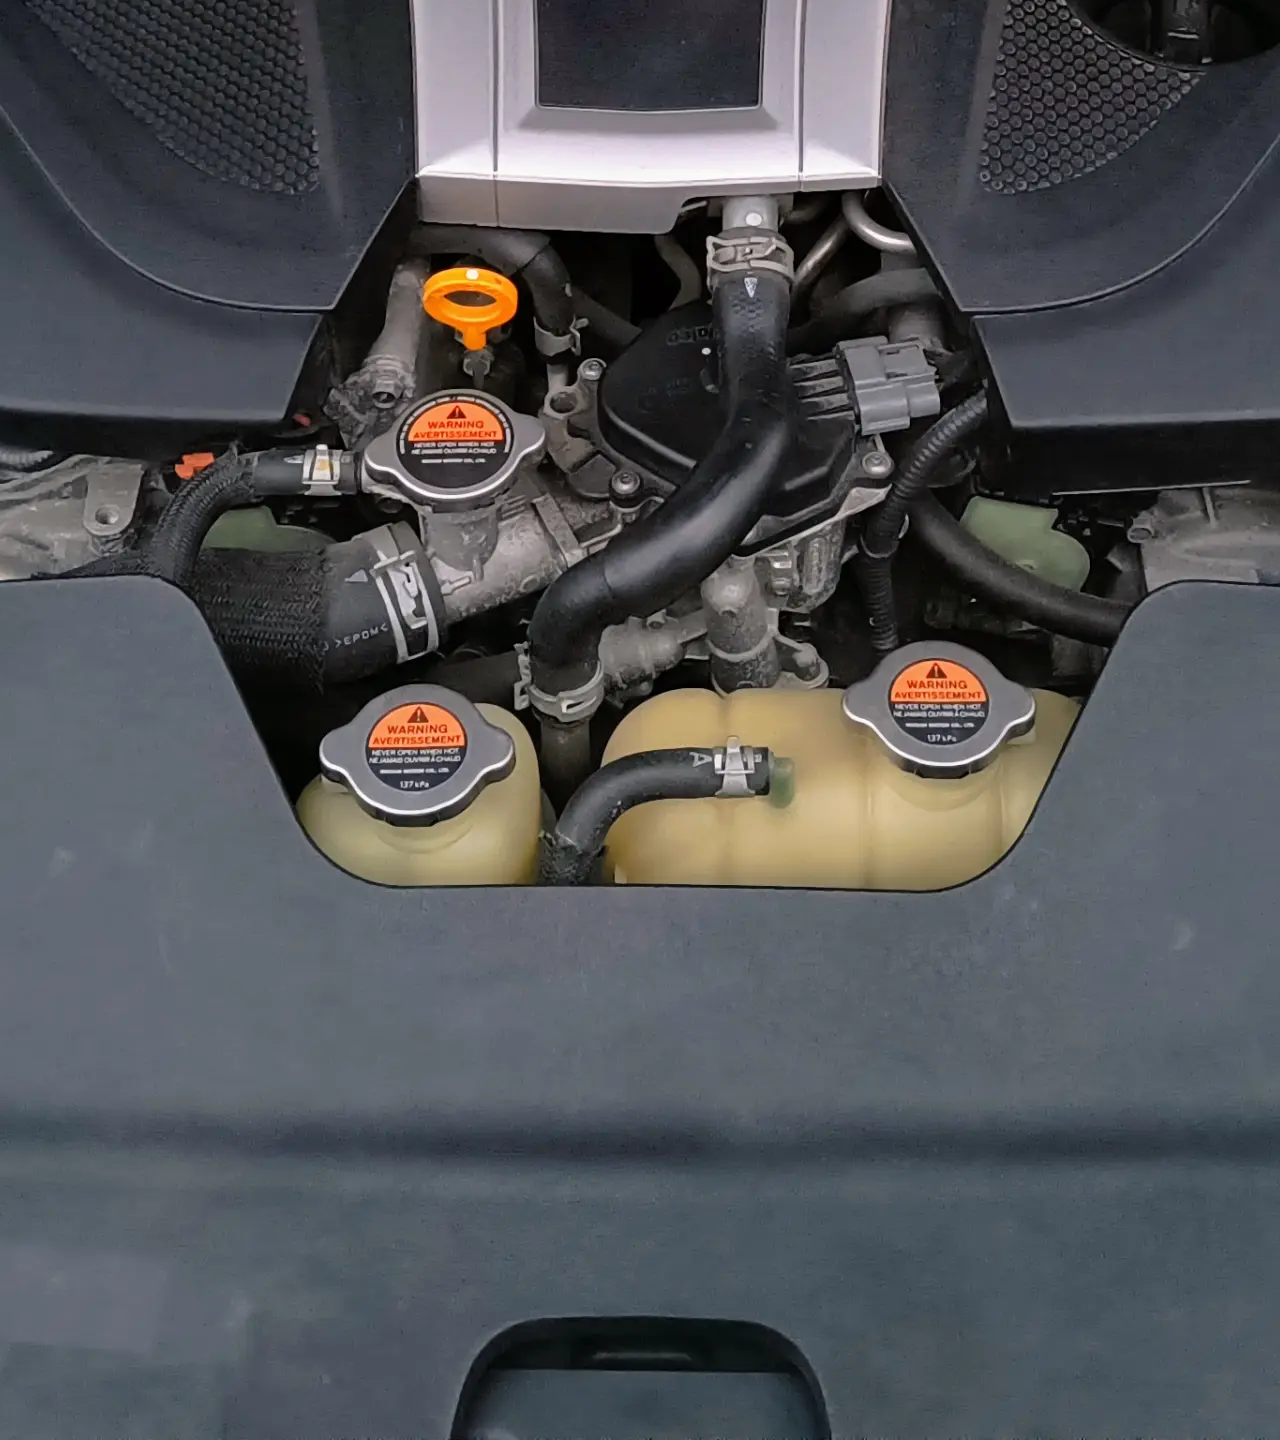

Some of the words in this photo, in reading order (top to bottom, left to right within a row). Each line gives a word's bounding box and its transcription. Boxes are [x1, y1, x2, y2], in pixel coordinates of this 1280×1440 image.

[427, 420, 485, 429] WARNING
[413, 430, 498, 439] AVERTISSEMENT
[906, 679, 968, 689] WARNING
[894, 691, 982, 699] AVERTISSEMENT
[387, 724, 448, 734] WARNING
[372, 735, 462, 745] AVERTISSEMENT
[400, 780, 414, 789] 137
[414, 780, 430, 788] kPa
